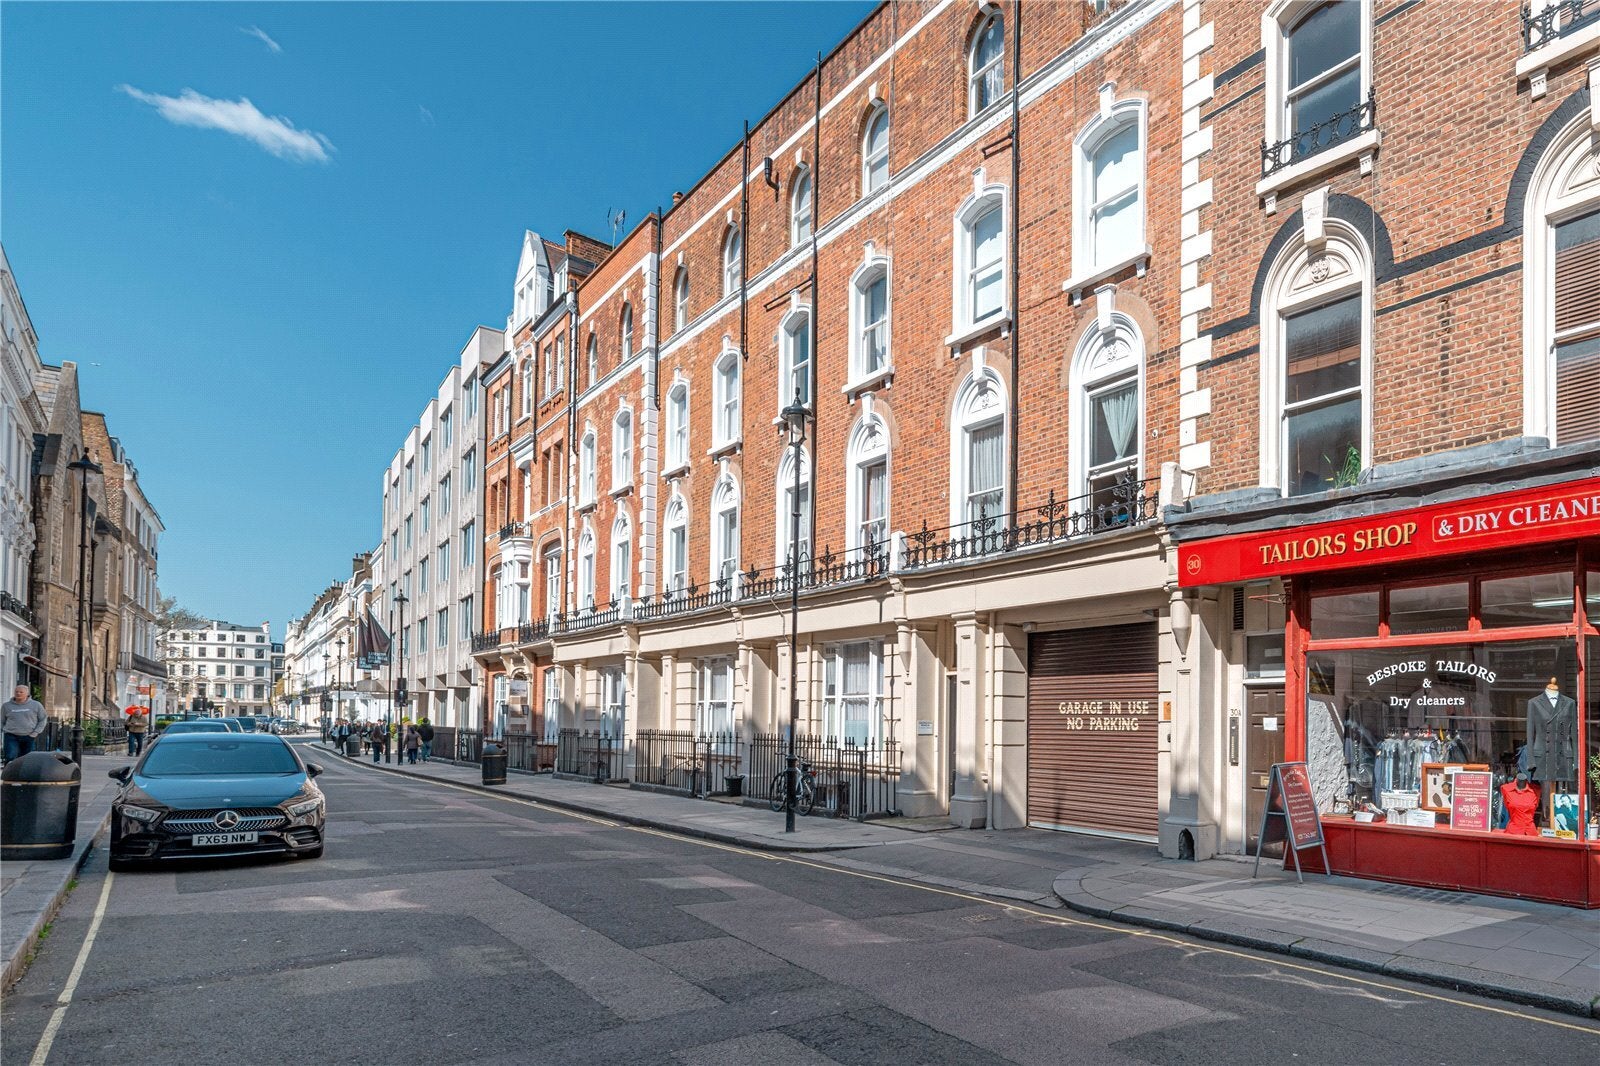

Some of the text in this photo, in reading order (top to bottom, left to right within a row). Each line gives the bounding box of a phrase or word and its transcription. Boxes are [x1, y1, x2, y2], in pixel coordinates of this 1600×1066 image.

[1438, 519, 1455, 536] &
[1457, 511, 1502, 534] DRY
[1259, 522, 1417, 565] TAILORS SHOP
[1188, 559, 1200, 569] 30
[1366, 660, 1497, 686] BESPOKE TAILORS
[1422, 678, 1432, 688] &
[1058, 701, 1149, 714] GARAGE IN USE
[1390, 695, 1465, 709] Dry cleaners
[1066, 717, 1139, 731] NO PARKING
[197, 833, 254, 845] FX69 NWJ
